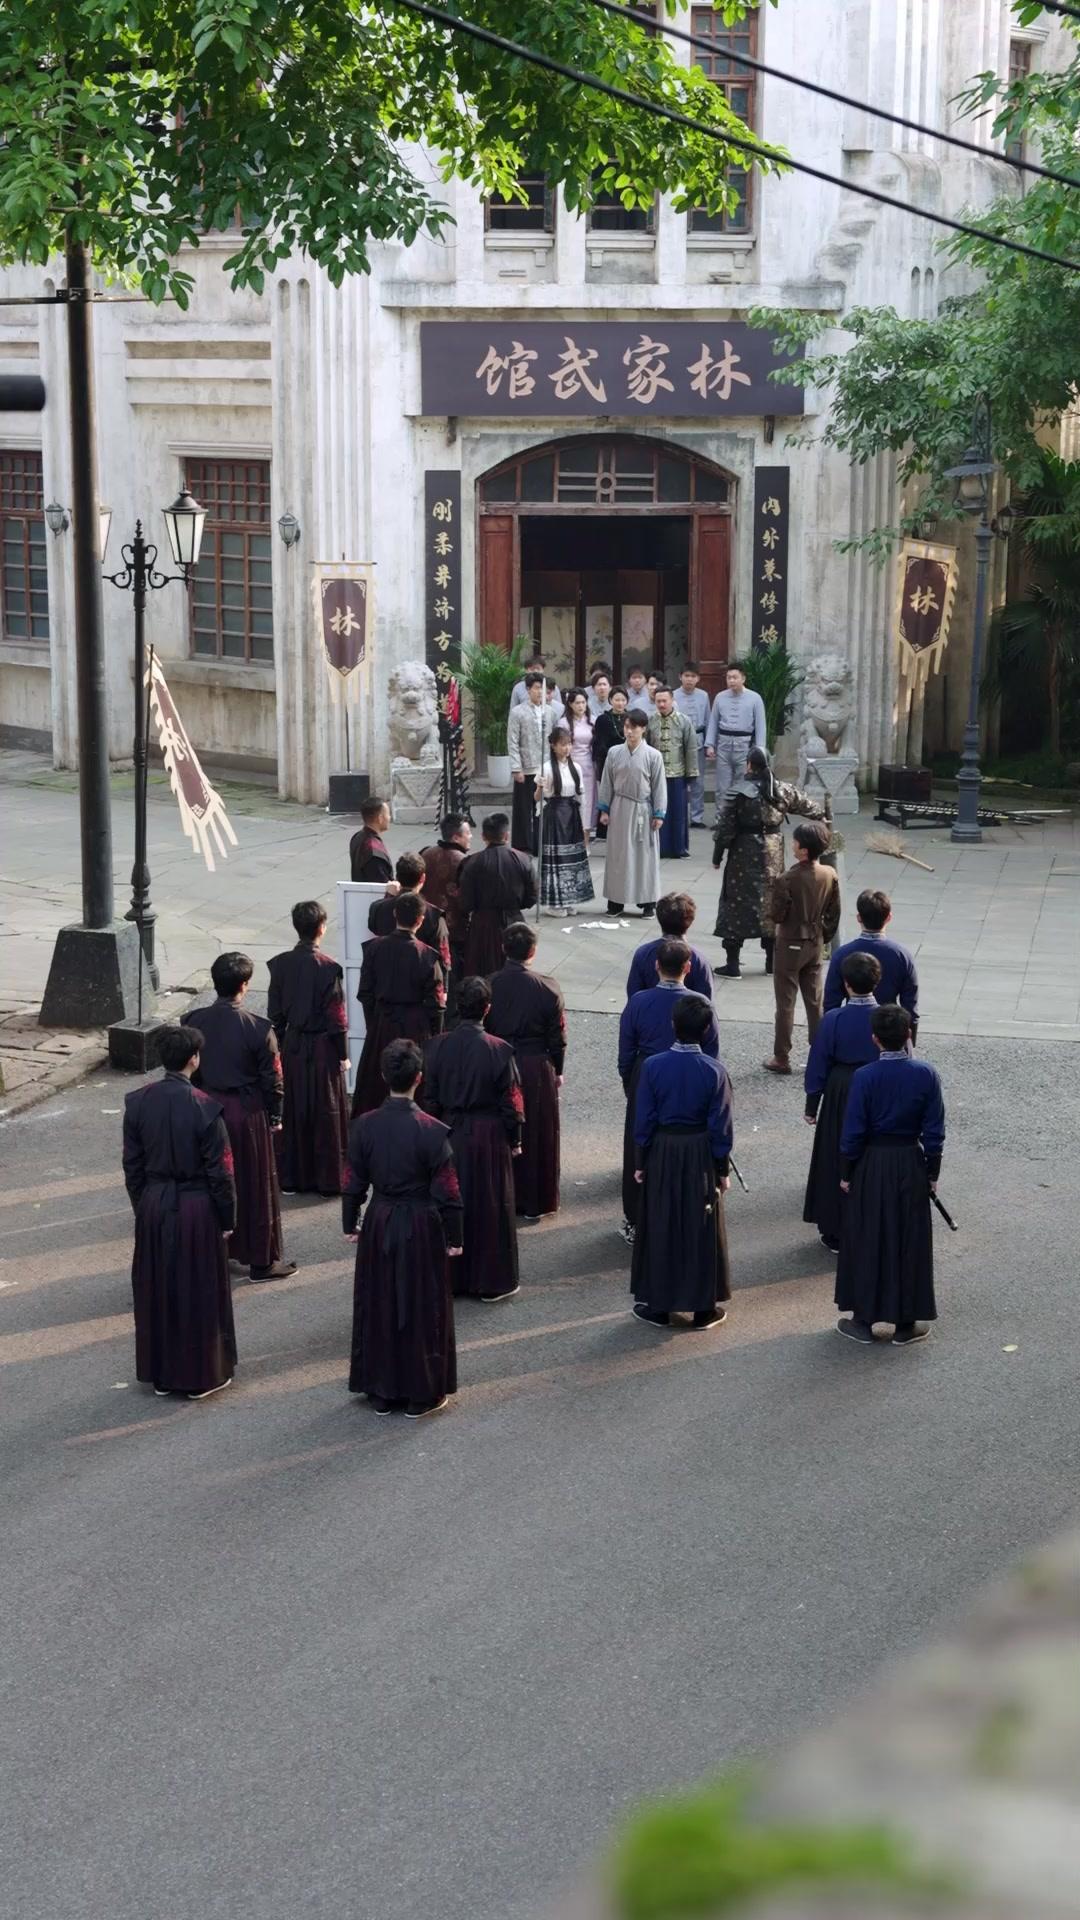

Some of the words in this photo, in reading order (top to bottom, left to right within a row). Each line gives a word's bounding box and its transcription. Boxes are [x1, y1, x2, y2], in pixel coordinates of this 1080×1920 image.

[475, 334, 751, 404] 林家武馆
[909, 585, 940, 616] 林
[329, 604, 361, 637] 林
